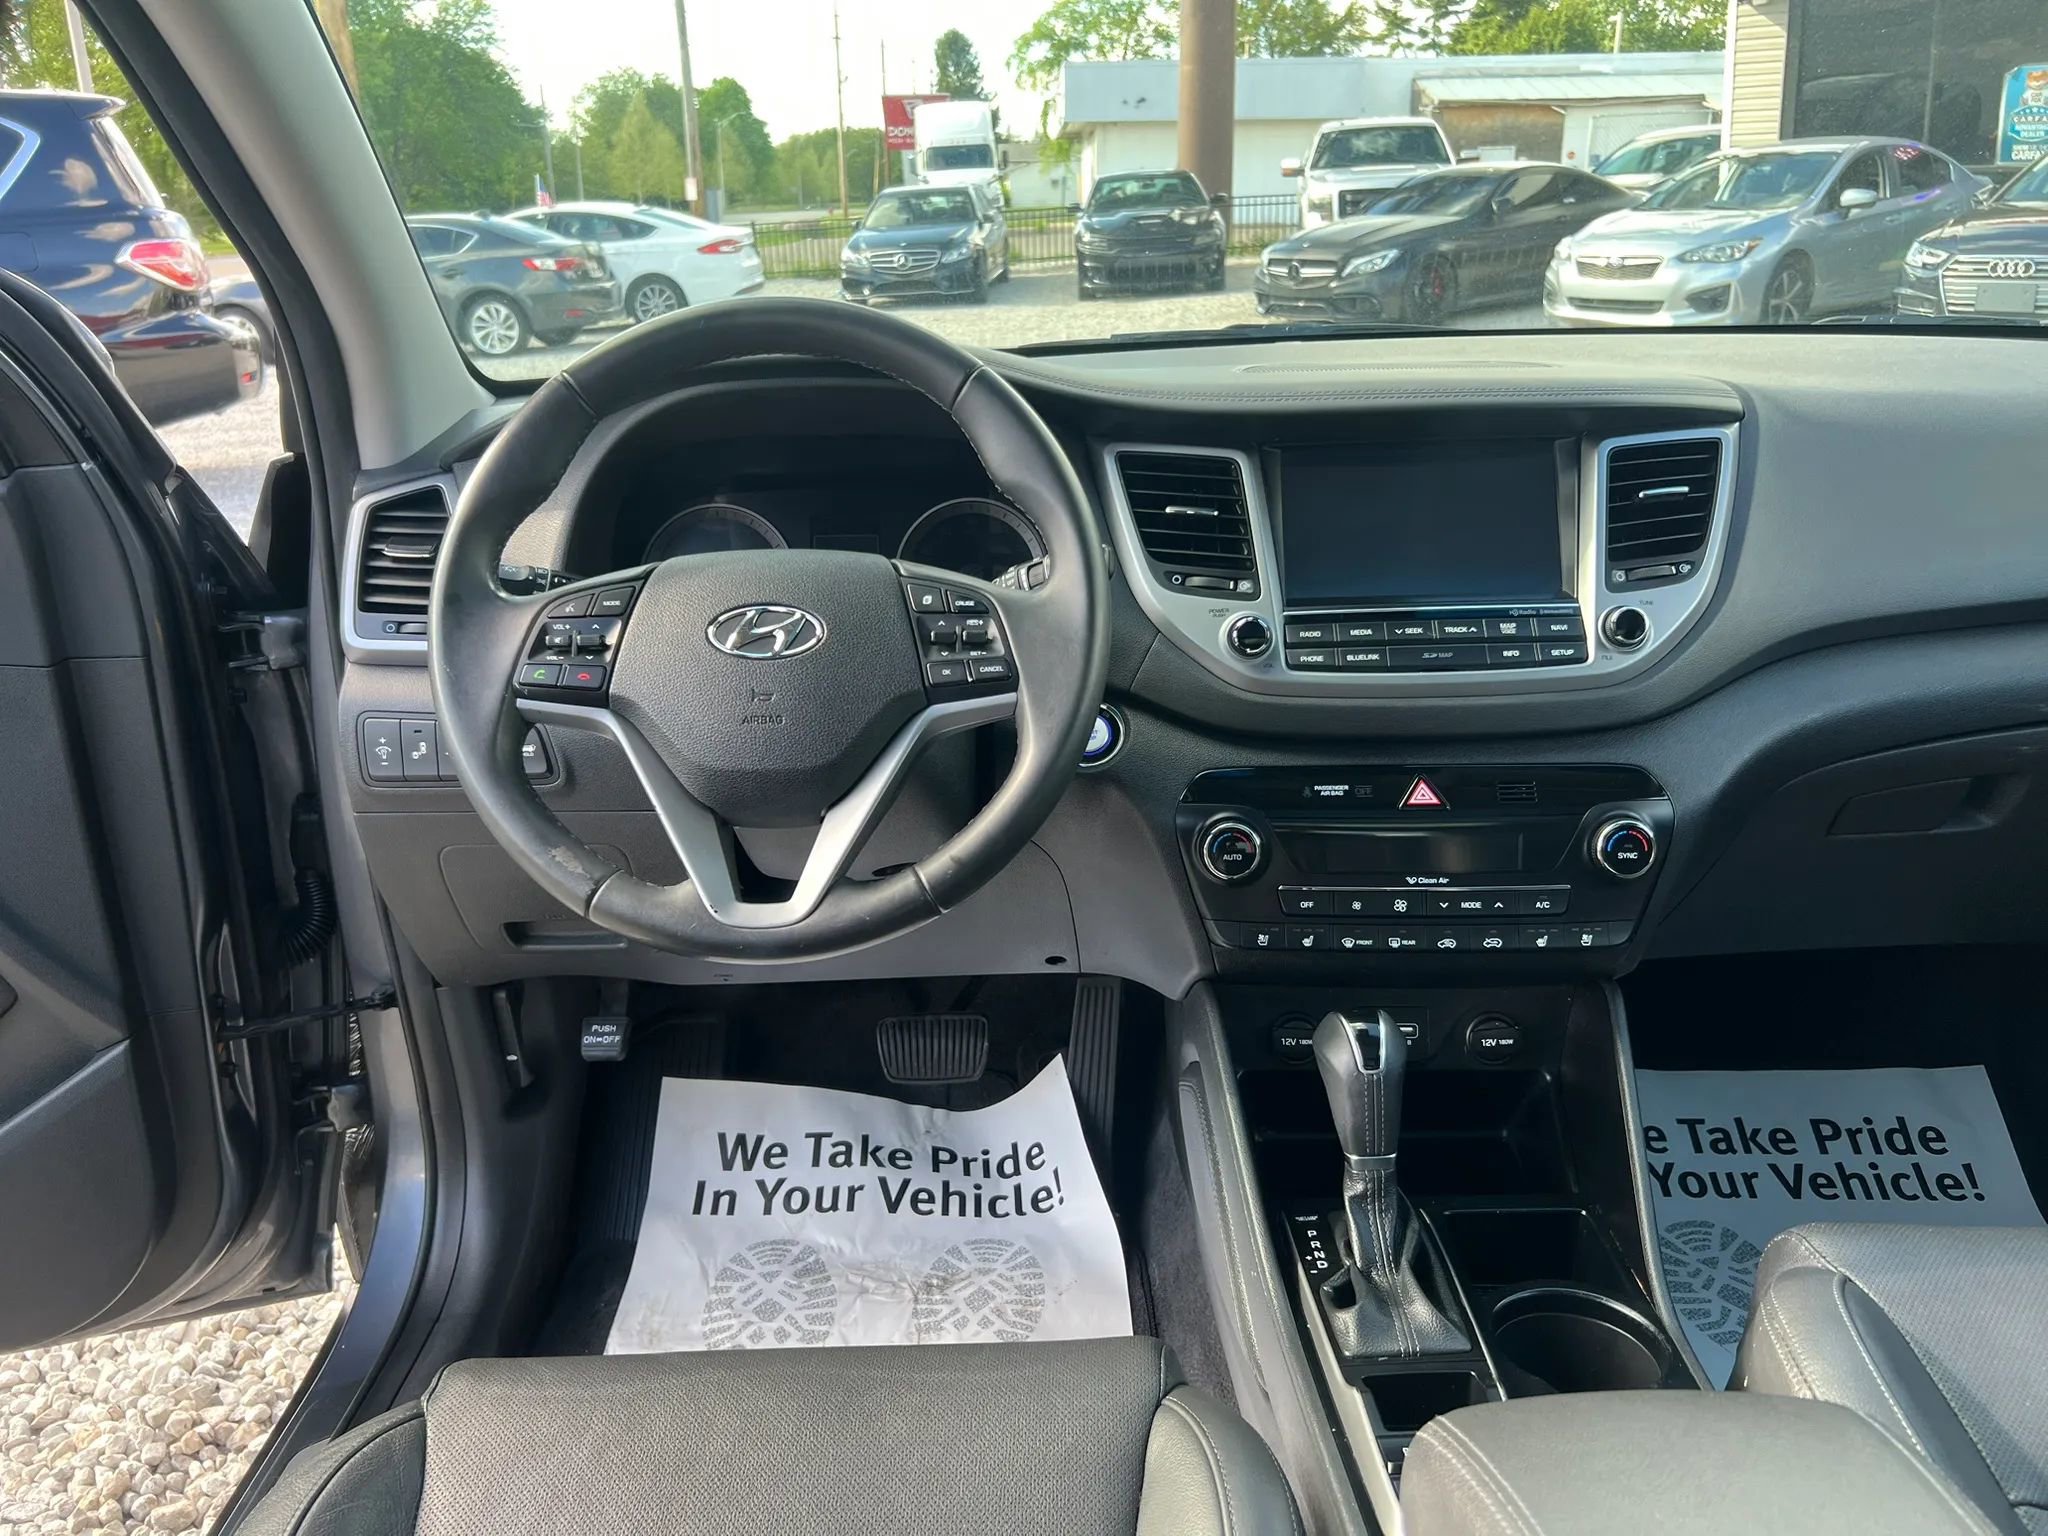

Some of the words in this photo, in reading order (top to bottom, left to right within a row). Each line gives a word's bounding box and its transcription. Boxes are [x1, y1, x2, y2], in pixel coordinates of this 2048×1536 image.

[1300, 630, 1321, 638] RADIO
[1404, 627, 1424, 635] SEEK
[1346, 653, 1380, 661] BLUELINK
[741, 715, 785, 725] AIRBAG
[1222, 853, 1243, 861] AUTO
[1461, 901, 1482, 909] MODE
[1535, 901, 1550, 909] A/C
[591, 1024, 617, 1032] PUSH
[1280, 1037, 1297, 1046] 12V
[1481, 1038, 1497, 1047] 12V
[1644, 1125, 1668, 1154] e
[1675, 1116, 1799, 1156] Take
[1809, 1116, 1949, 1156] Pride
[717, 1131, 789, 1172] We
[804, 1131, 914, 1170] Take
[931, 1141, 1045, 1180] Pride
[1648, 1162, 1759, 1199] Your
[1767, 1162, 1986, 1201] Vehicle!
[692, 1180, 738, 1216] In
[755, 1177, 866, 1216] Your
[877, 1166, 1065, 1219] Vehicle!
[1307, 1230, 1317, 1238] P
[1310, 1240, 1321, 1249] R
[1314, 1250, 1325, 1259] N
[1316, 1260, 1329, 1269] D
